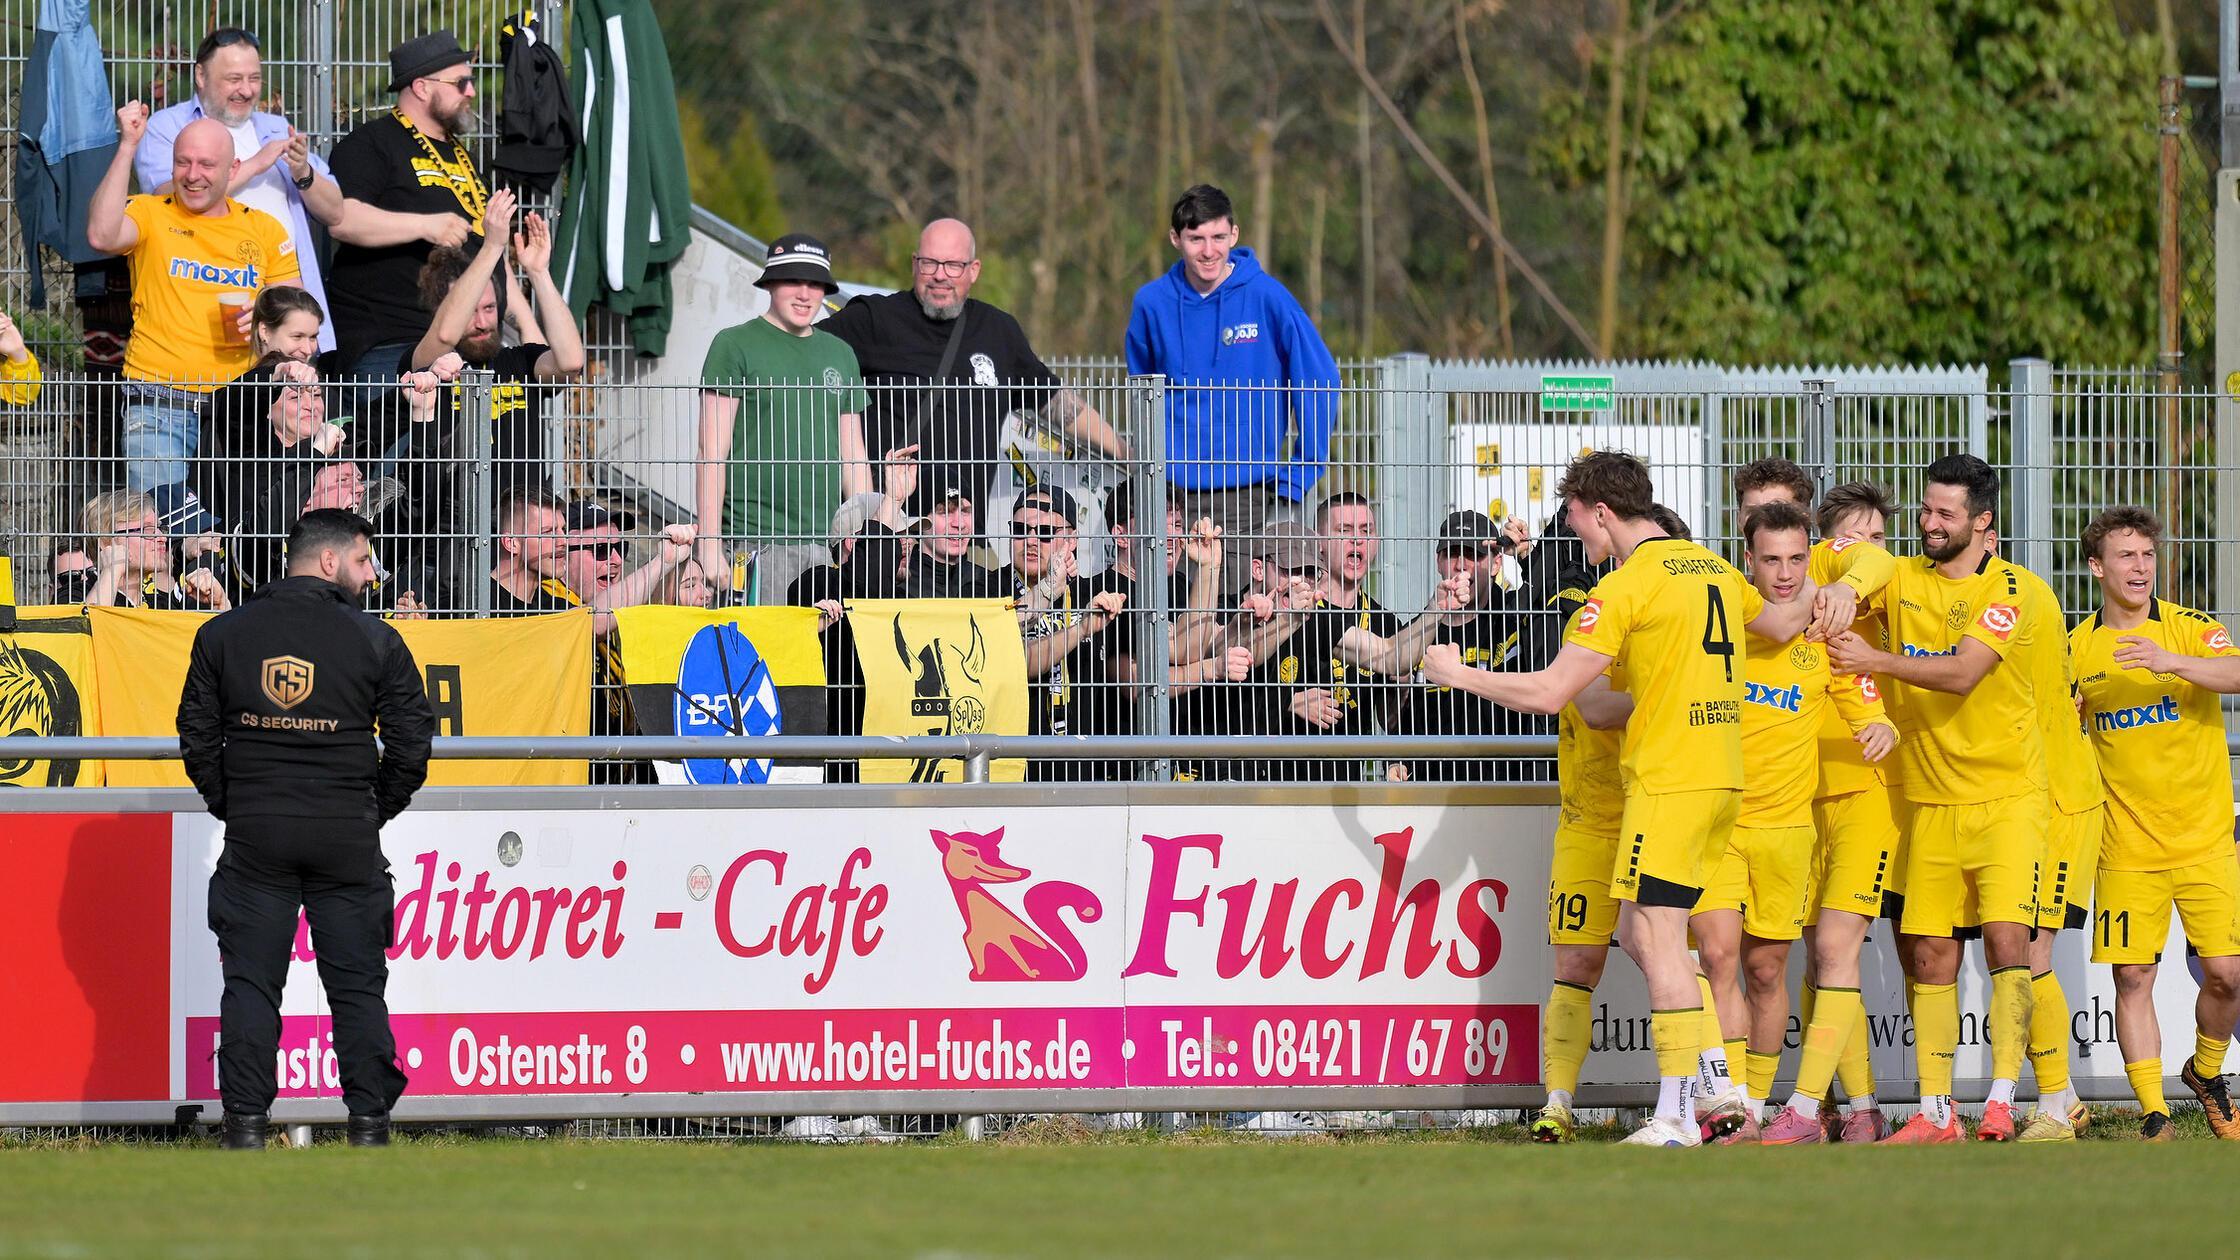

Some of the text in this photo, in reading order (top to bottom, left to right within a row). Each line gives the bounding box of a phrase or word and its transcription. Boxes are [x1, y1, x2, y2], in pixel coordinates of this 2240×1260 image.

[170, 257, 259, 289] maxit
[1702, 583, 1735, 683] 4
[268, 661, 307, 704] CS
[2082, 671, 2106, 683] capelli
[1744, 681, 1804, 713] axit
[2094, 695, 2180, 732] maxit
[241, 712, 339, 732] CS SECURITY
[715, 847, 889, 995] Cafe
[1121, 826, 1509, 982] Fuchs
[1555, 893, 1588, 931] 19
[2099, 909, 2129, 948] 11
[449, 1027, 613, 1086] Ostenstr.
[625, 1026, 648, 1085] 8
[721, 1018, 1091, 1083] www.hotel-fuchs.de
[1161, 1017, 1239, 1078] Tel.:
[1253, 1018, 1361, 1078] 08421
[1406, 1019, 1453, 1077] 67
[1464, 1018, 1509, 1077] 89
